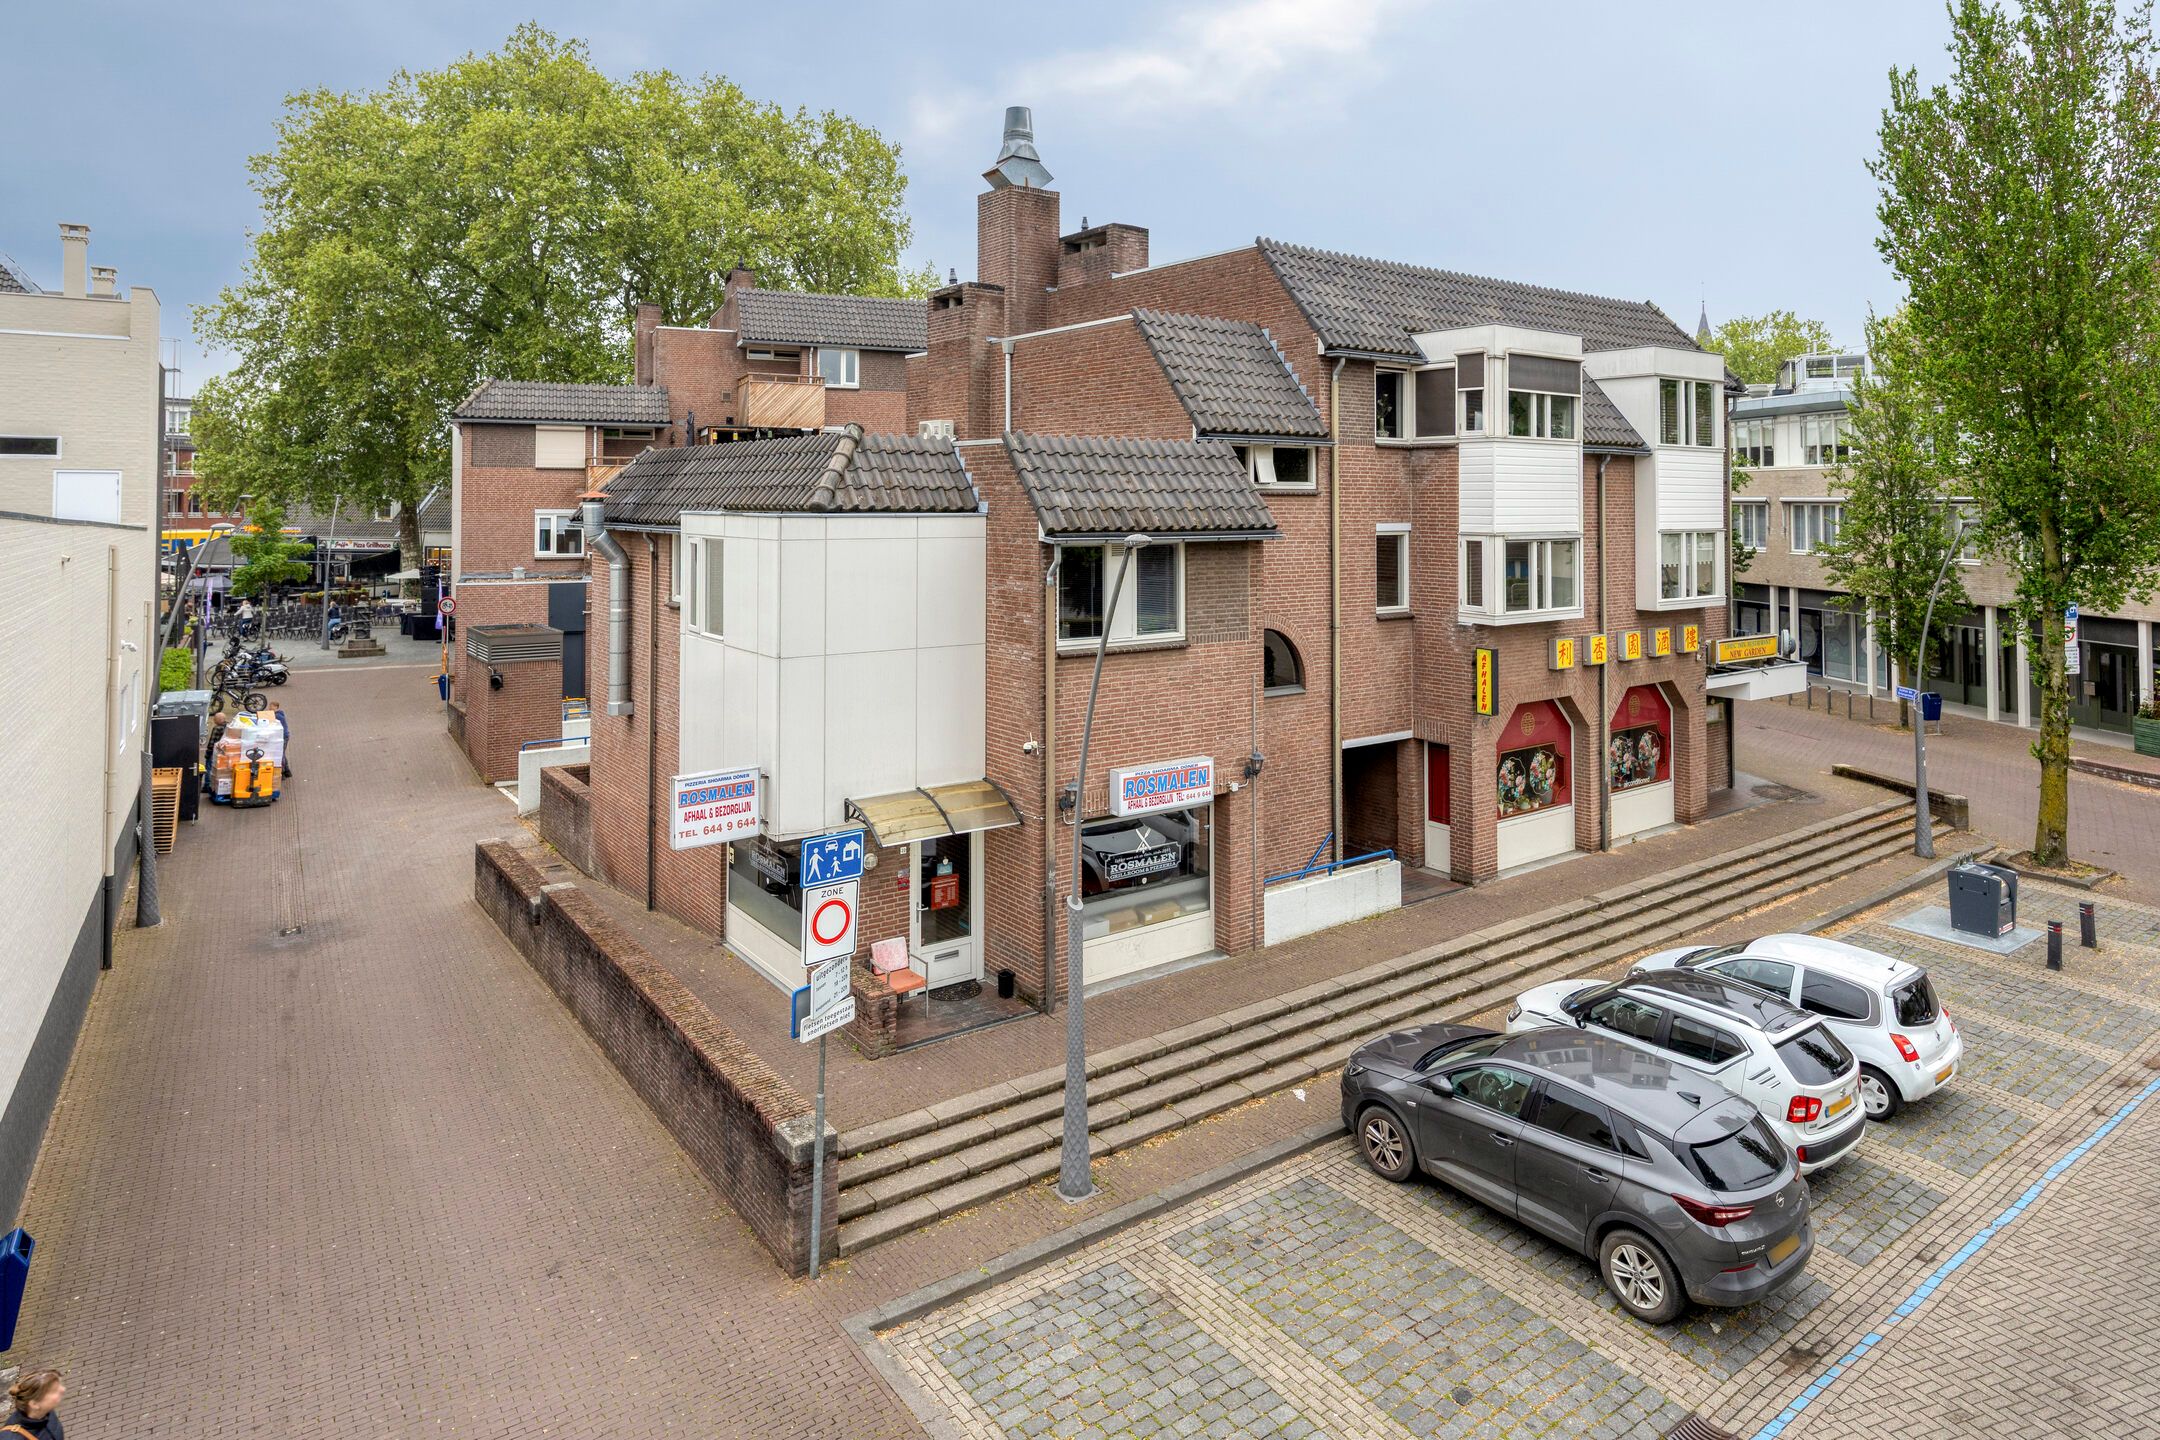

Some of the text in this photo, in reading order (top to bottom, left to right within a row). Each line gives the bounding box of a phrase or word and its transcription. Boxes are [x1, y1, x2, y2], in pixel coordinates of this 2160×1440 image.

[1729, 647, 1766, 658] NEW GARDEN
[1152, 766, 1180, 774] SHOARMA
[684, 780, 707, 788] PIZZERIA
[707, 776, 732, 784] SHOARMA
[1125, 769, 1207, 798] ROSMALEN
[680, 783, 753, 806] ROSMALEN
[1127, 798, 1144, 810] AFHAAL
[1148, 793, 1174, 807] BEZORGLIJN
[1201, 790, 1211, 798] 644
[683, 801, 752, 823] AFHAAL & BEZORGLIJN
[679, 816, 756, 839] TEL 644 9 644
[1110, 852, 1177, 873] ROSMALEN
[821, 887, 844, 898] ZONE
[803, 1017, 824, 1031] fietsen
[824, 1003, 854, 1021] toegestaan
[807, 1012, 851, 1036] snorfietsen niet
